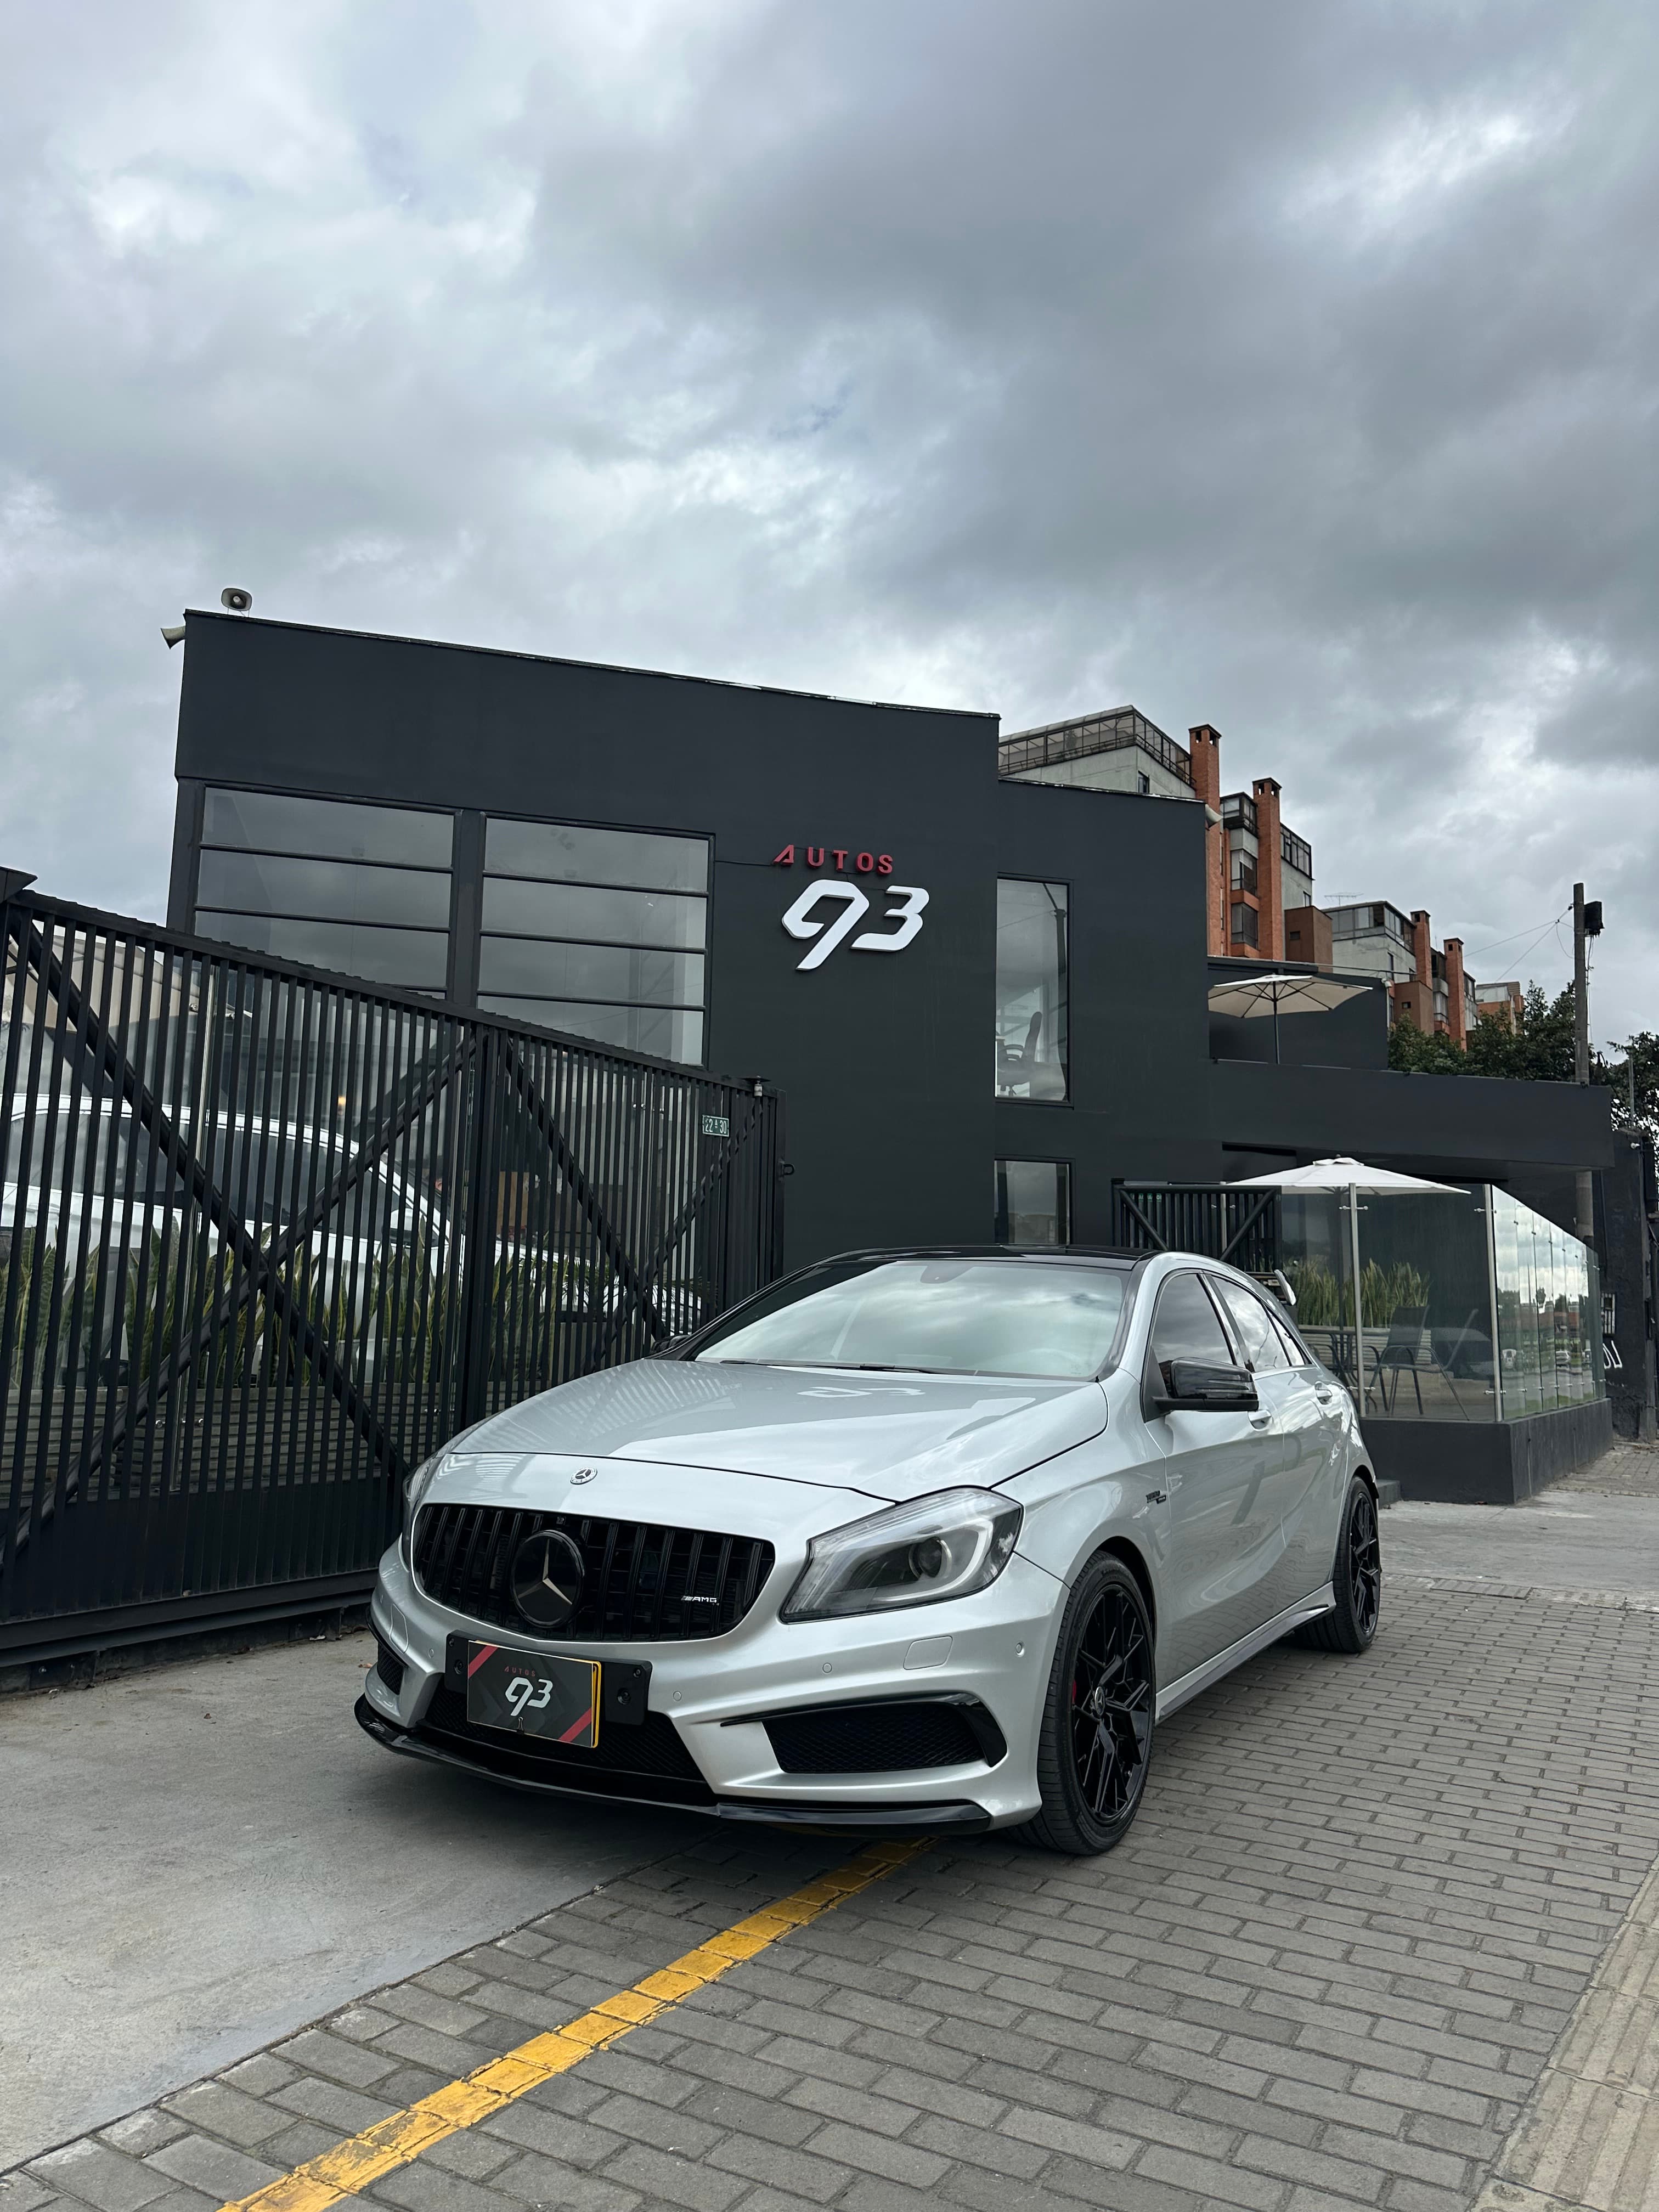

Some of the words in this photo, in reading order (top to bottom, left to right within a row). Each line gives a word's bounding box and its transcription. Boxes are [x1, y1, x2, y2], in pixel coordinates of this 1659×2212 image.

[773, 844, 893, 874] AUTOS
[781, 879, 929, 971] 93
[505, 1666, 535, 1677] AUTOS
[505, 1677, 553, 1716] 93
